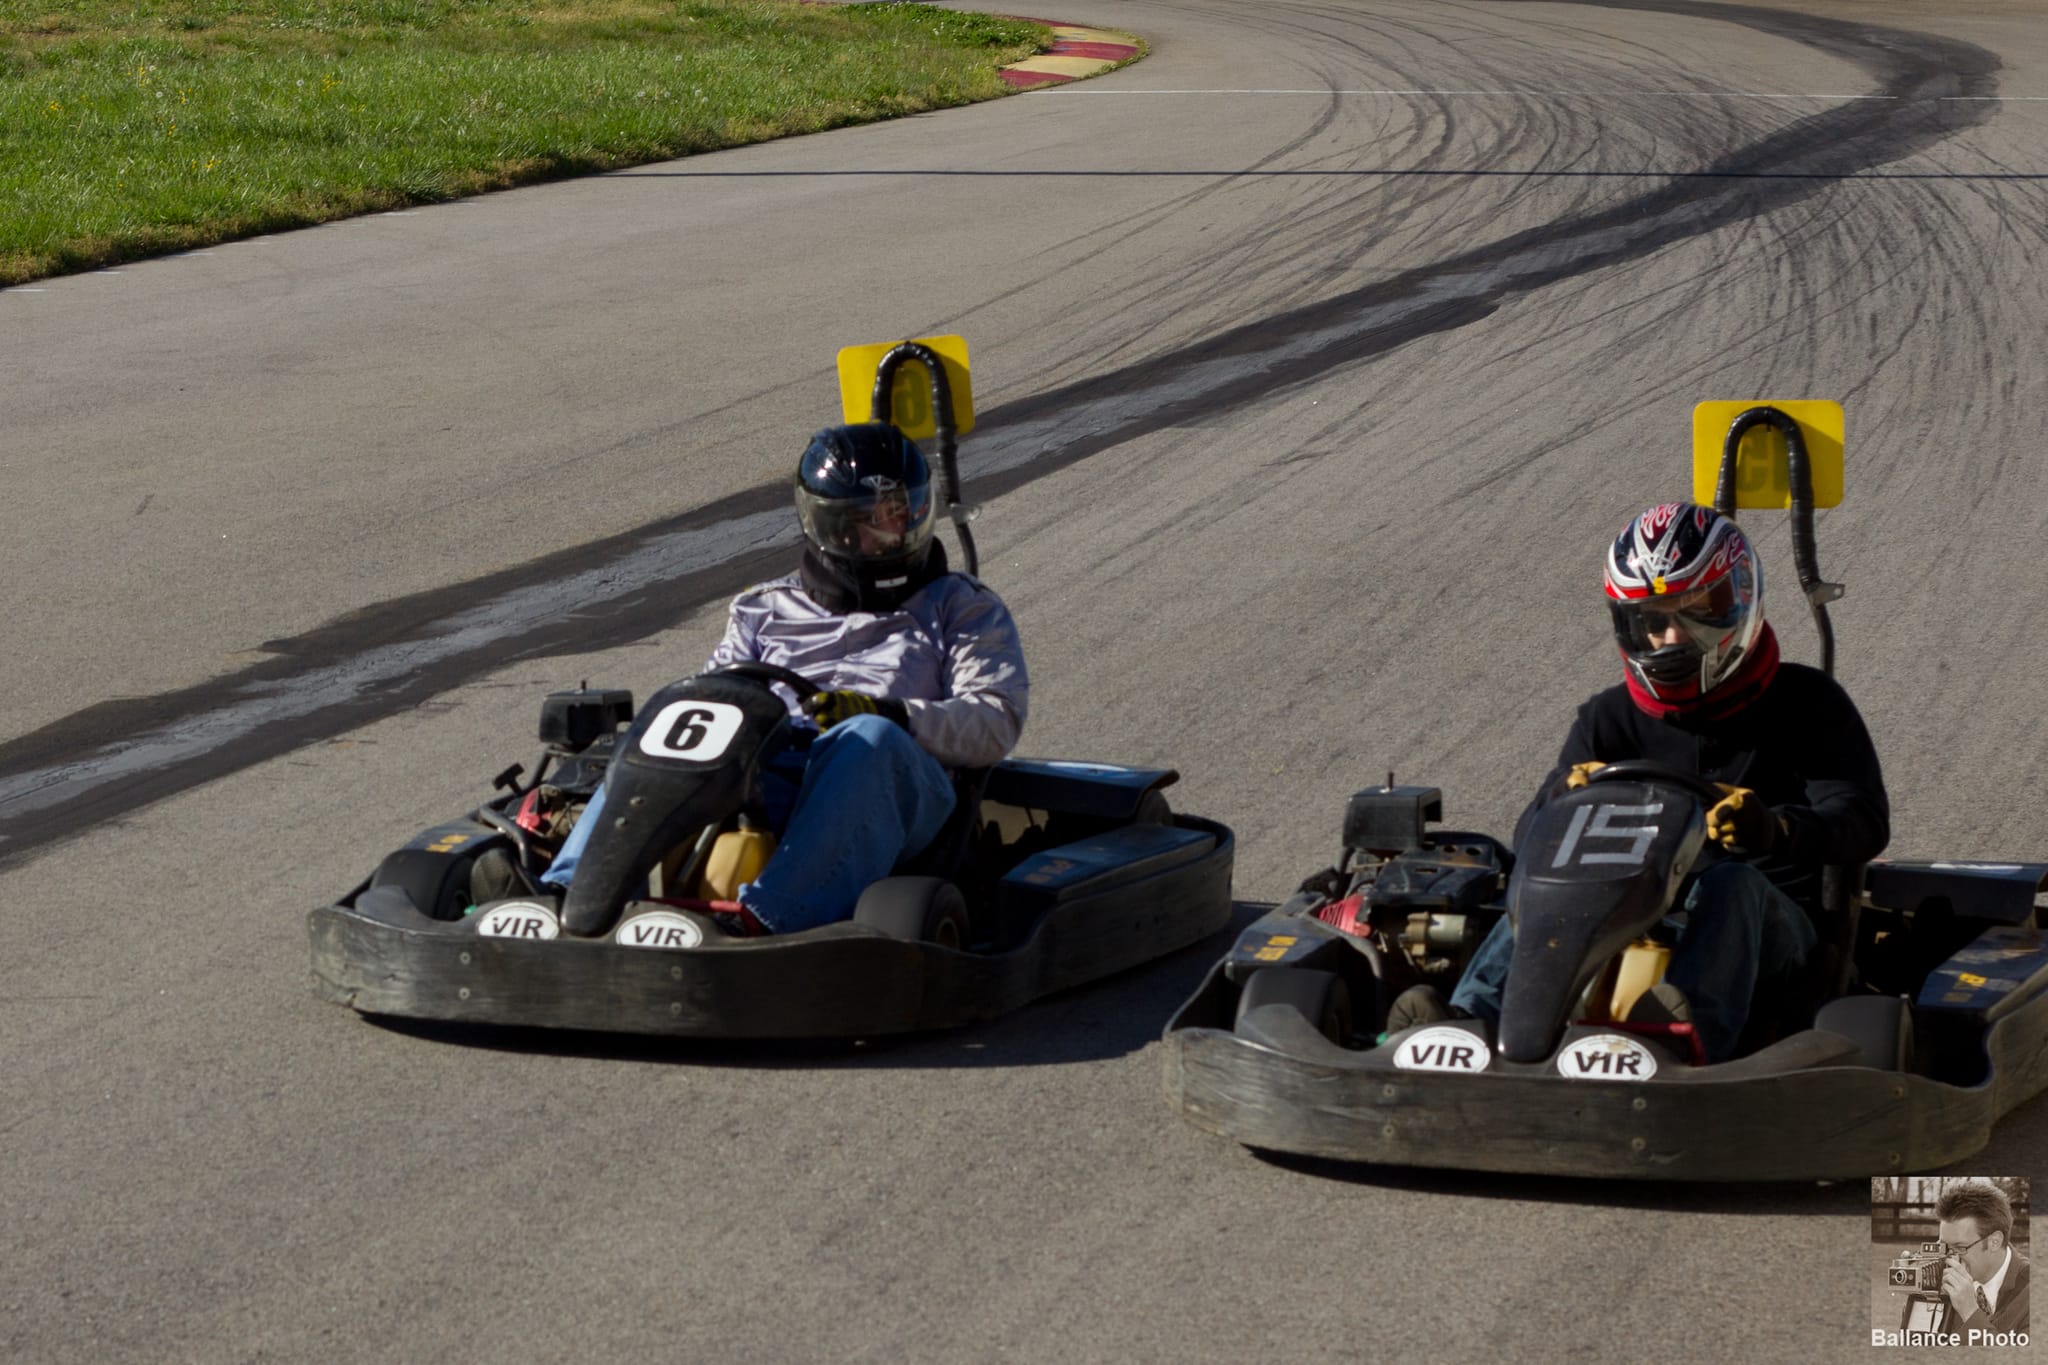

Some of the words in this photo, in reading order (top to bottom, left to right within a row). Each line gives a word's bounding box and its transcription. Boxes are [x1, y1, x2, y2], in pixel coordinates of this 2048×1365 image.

[663, 708, 716, 751] 6
[1551, 803, 1664, 869] 15
[492, 917, 544, 938] VIR
[633, 924, 686, 946] VIR
[1410, 1044, 1475, 1069] VIR
[1574, 1050, 1642, 1076] VIR
